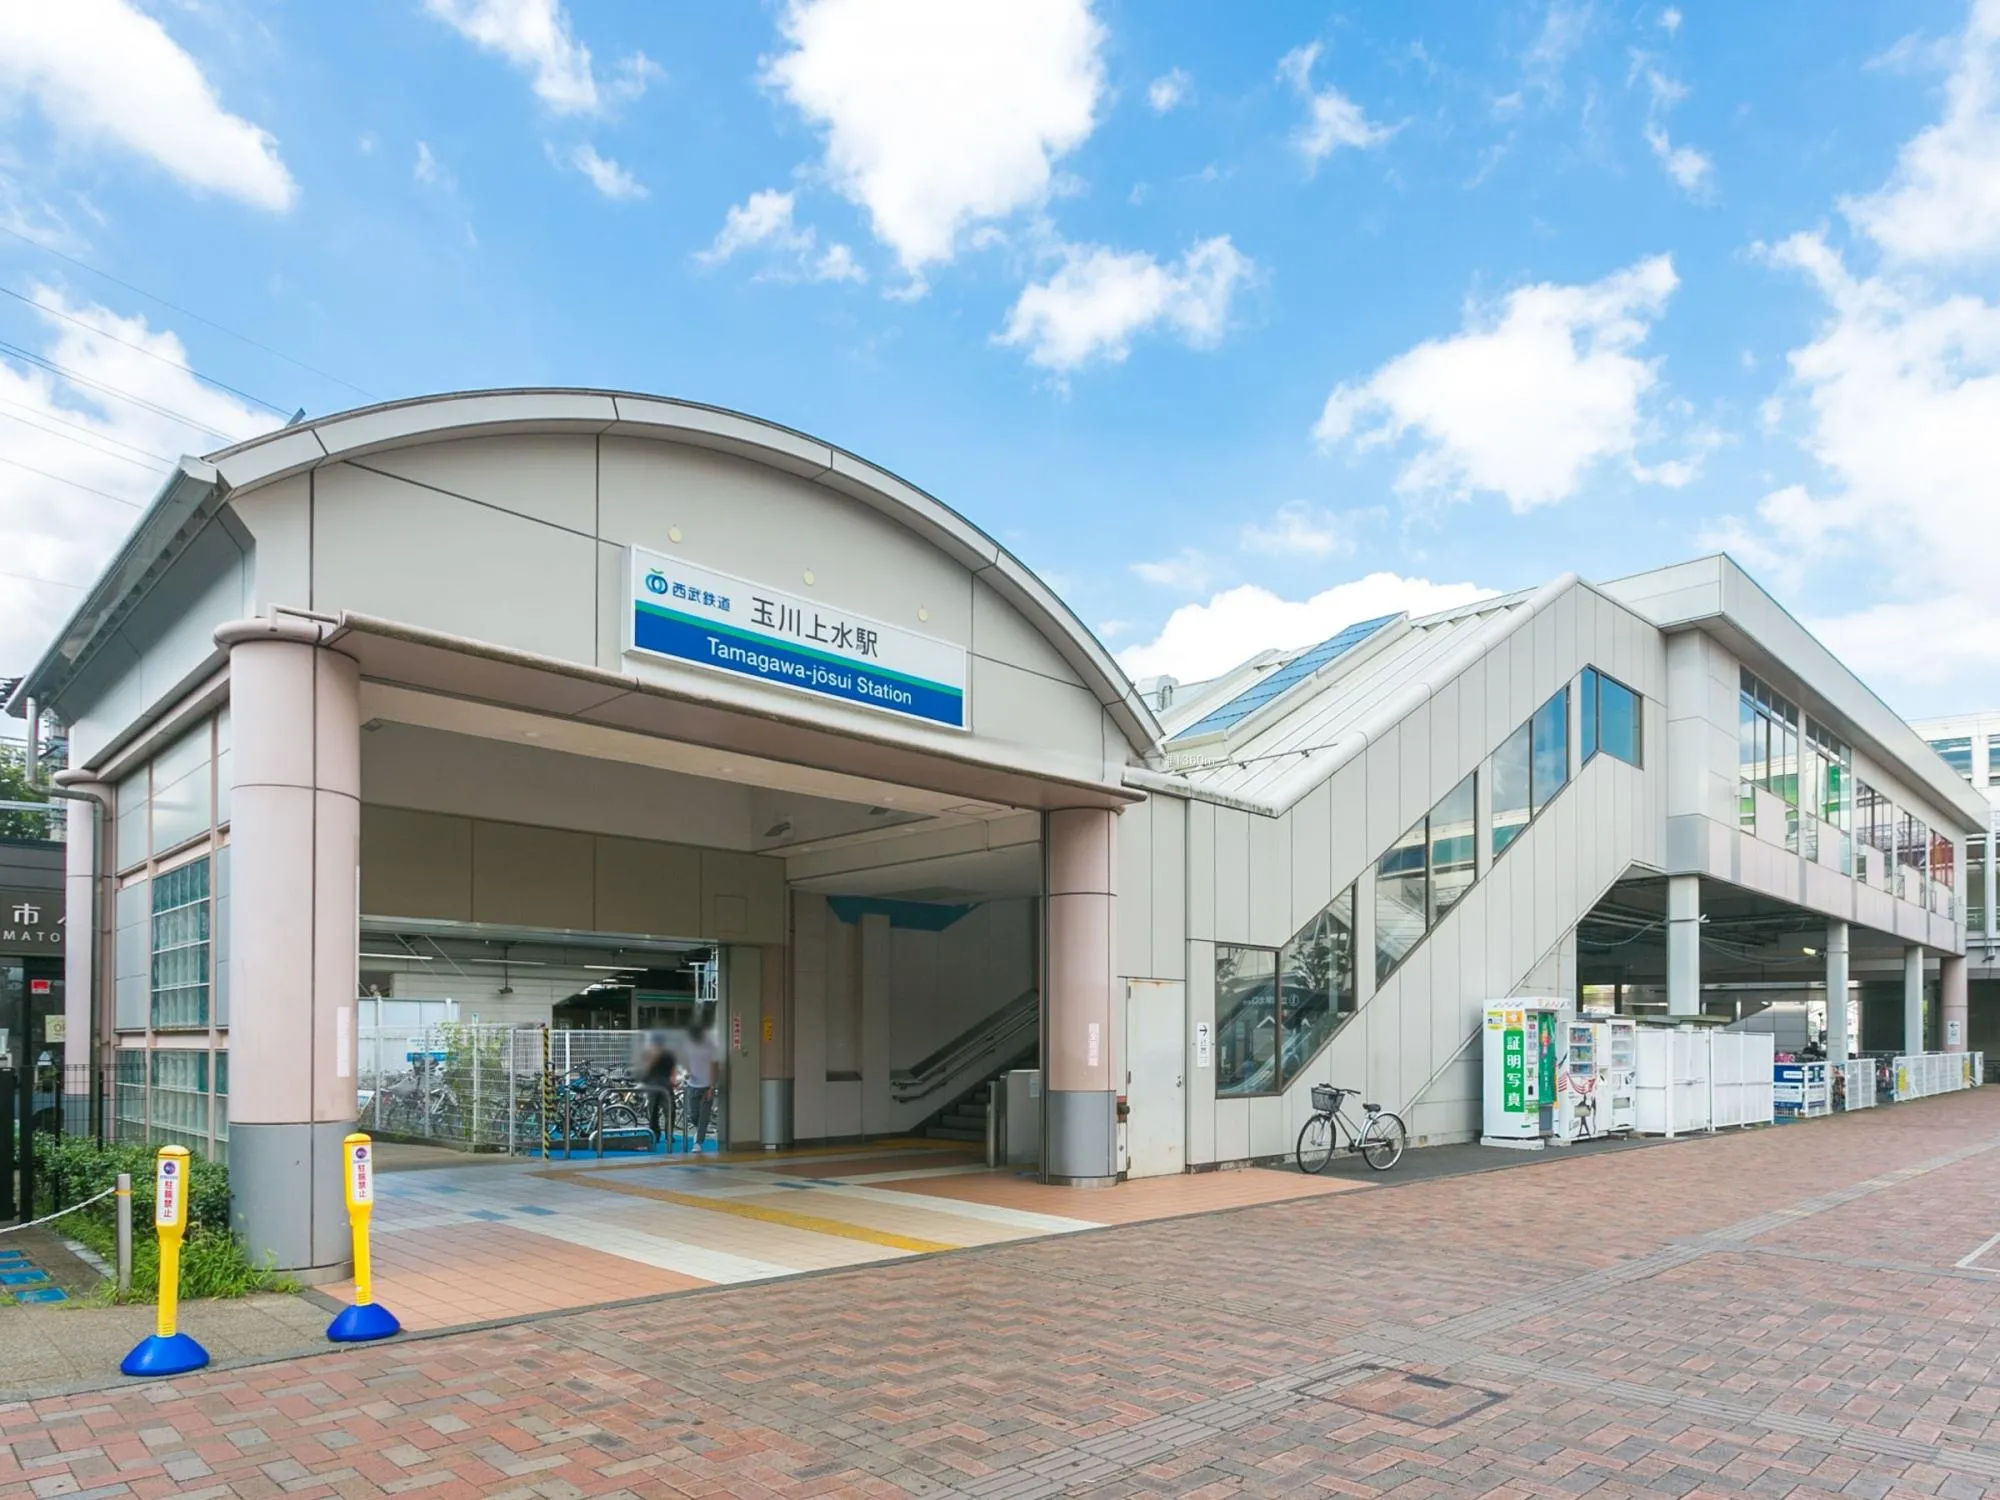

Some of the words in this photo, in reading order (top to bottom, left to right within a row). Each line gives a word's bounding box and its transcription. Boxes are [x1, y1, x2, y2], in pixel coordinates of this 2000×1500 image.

[672, 582, 731, 612] 西武鉄道
[751, 596, 878, 658] 玉川上水駅
[707, 636, 852, 690] Tamagawa-jōsui
[857, 676, 912, 705] Station
[1506, 1035, 1521, 1107] 証明写真
